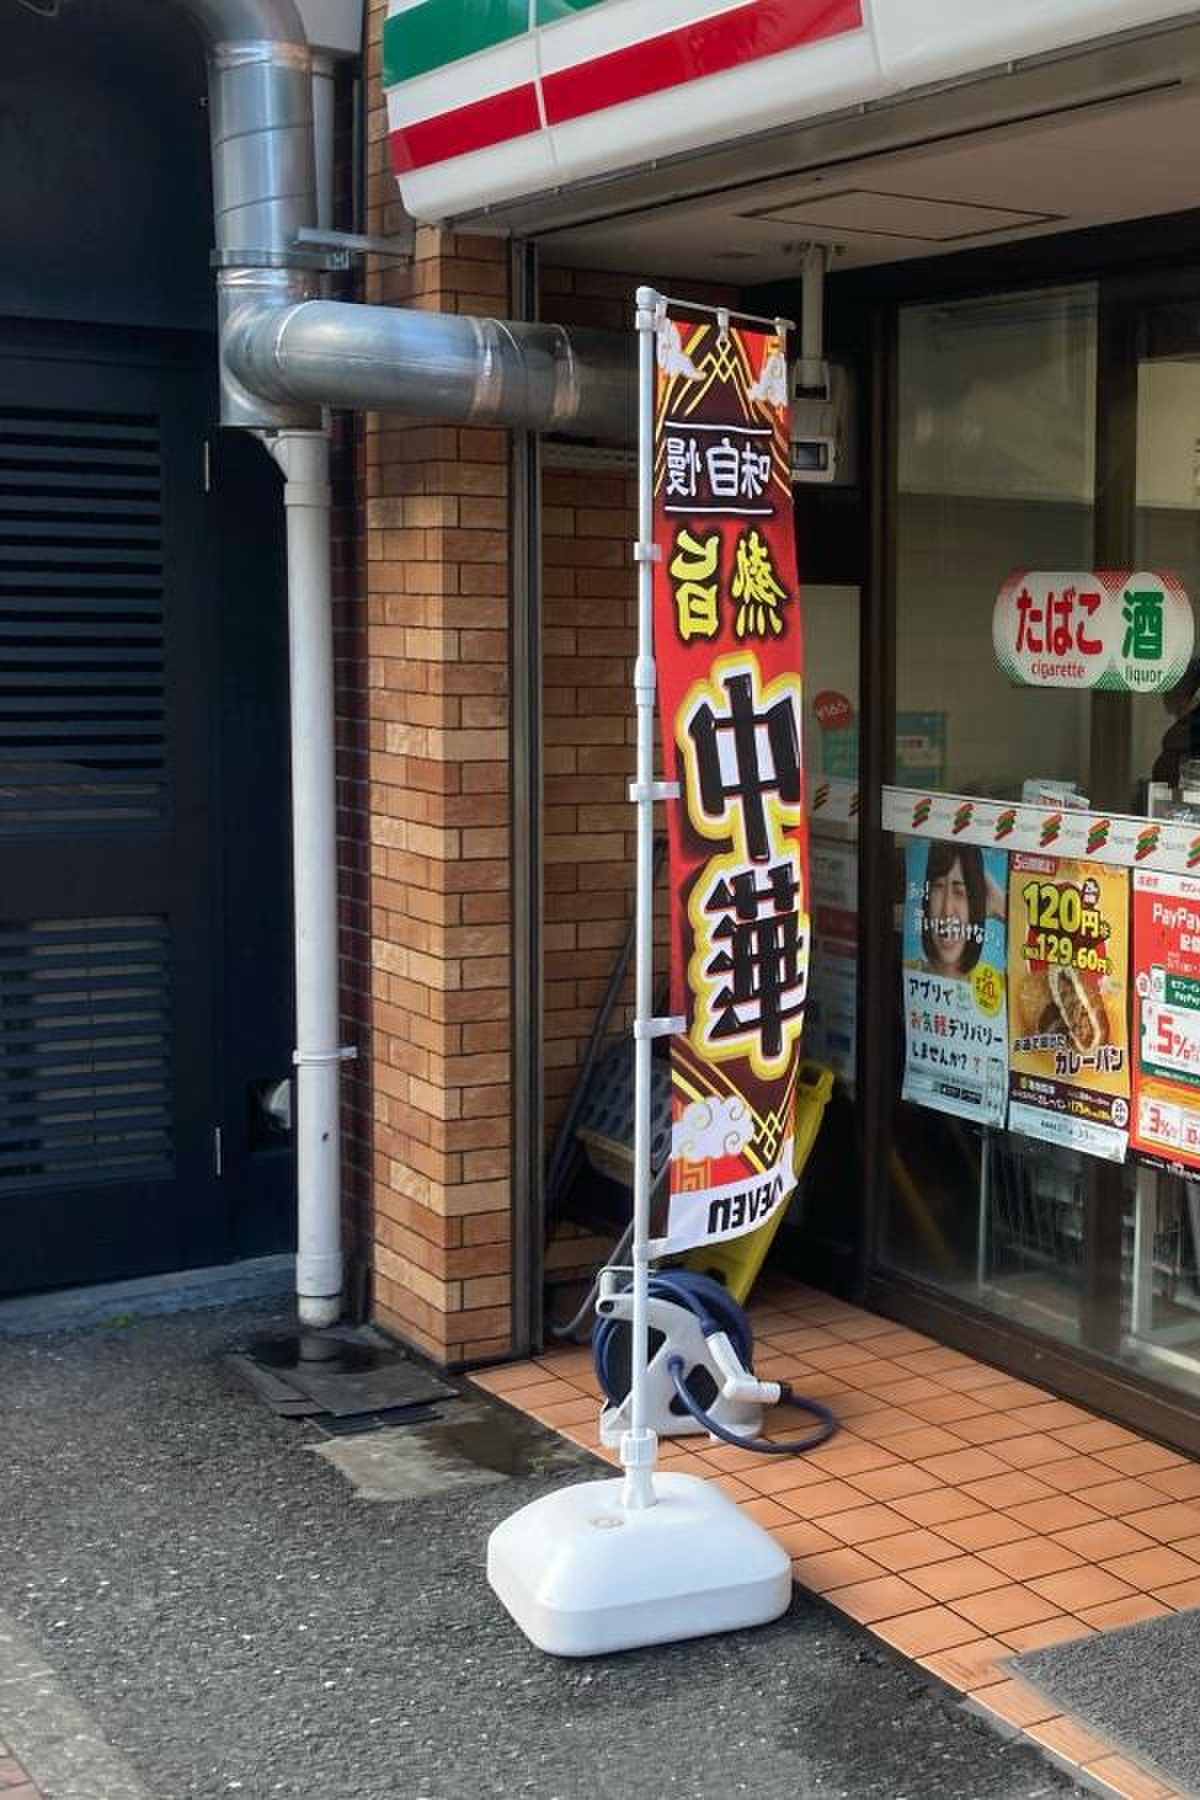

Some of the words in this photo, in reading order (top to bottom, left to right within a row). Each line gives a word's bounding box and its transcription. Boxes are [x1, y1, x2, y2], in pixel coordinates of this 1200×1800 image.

[1015, 586, 1104, 657] たばこ
[1121, 589, 1165, 660] 酒
[1030, 659, 1086, 679] cigarette
[1125, 665, 1164, 686] liquor
[909, 977, 953, 1006] アプリで
[1055, 1046, 1123, 1075] カレーパン
